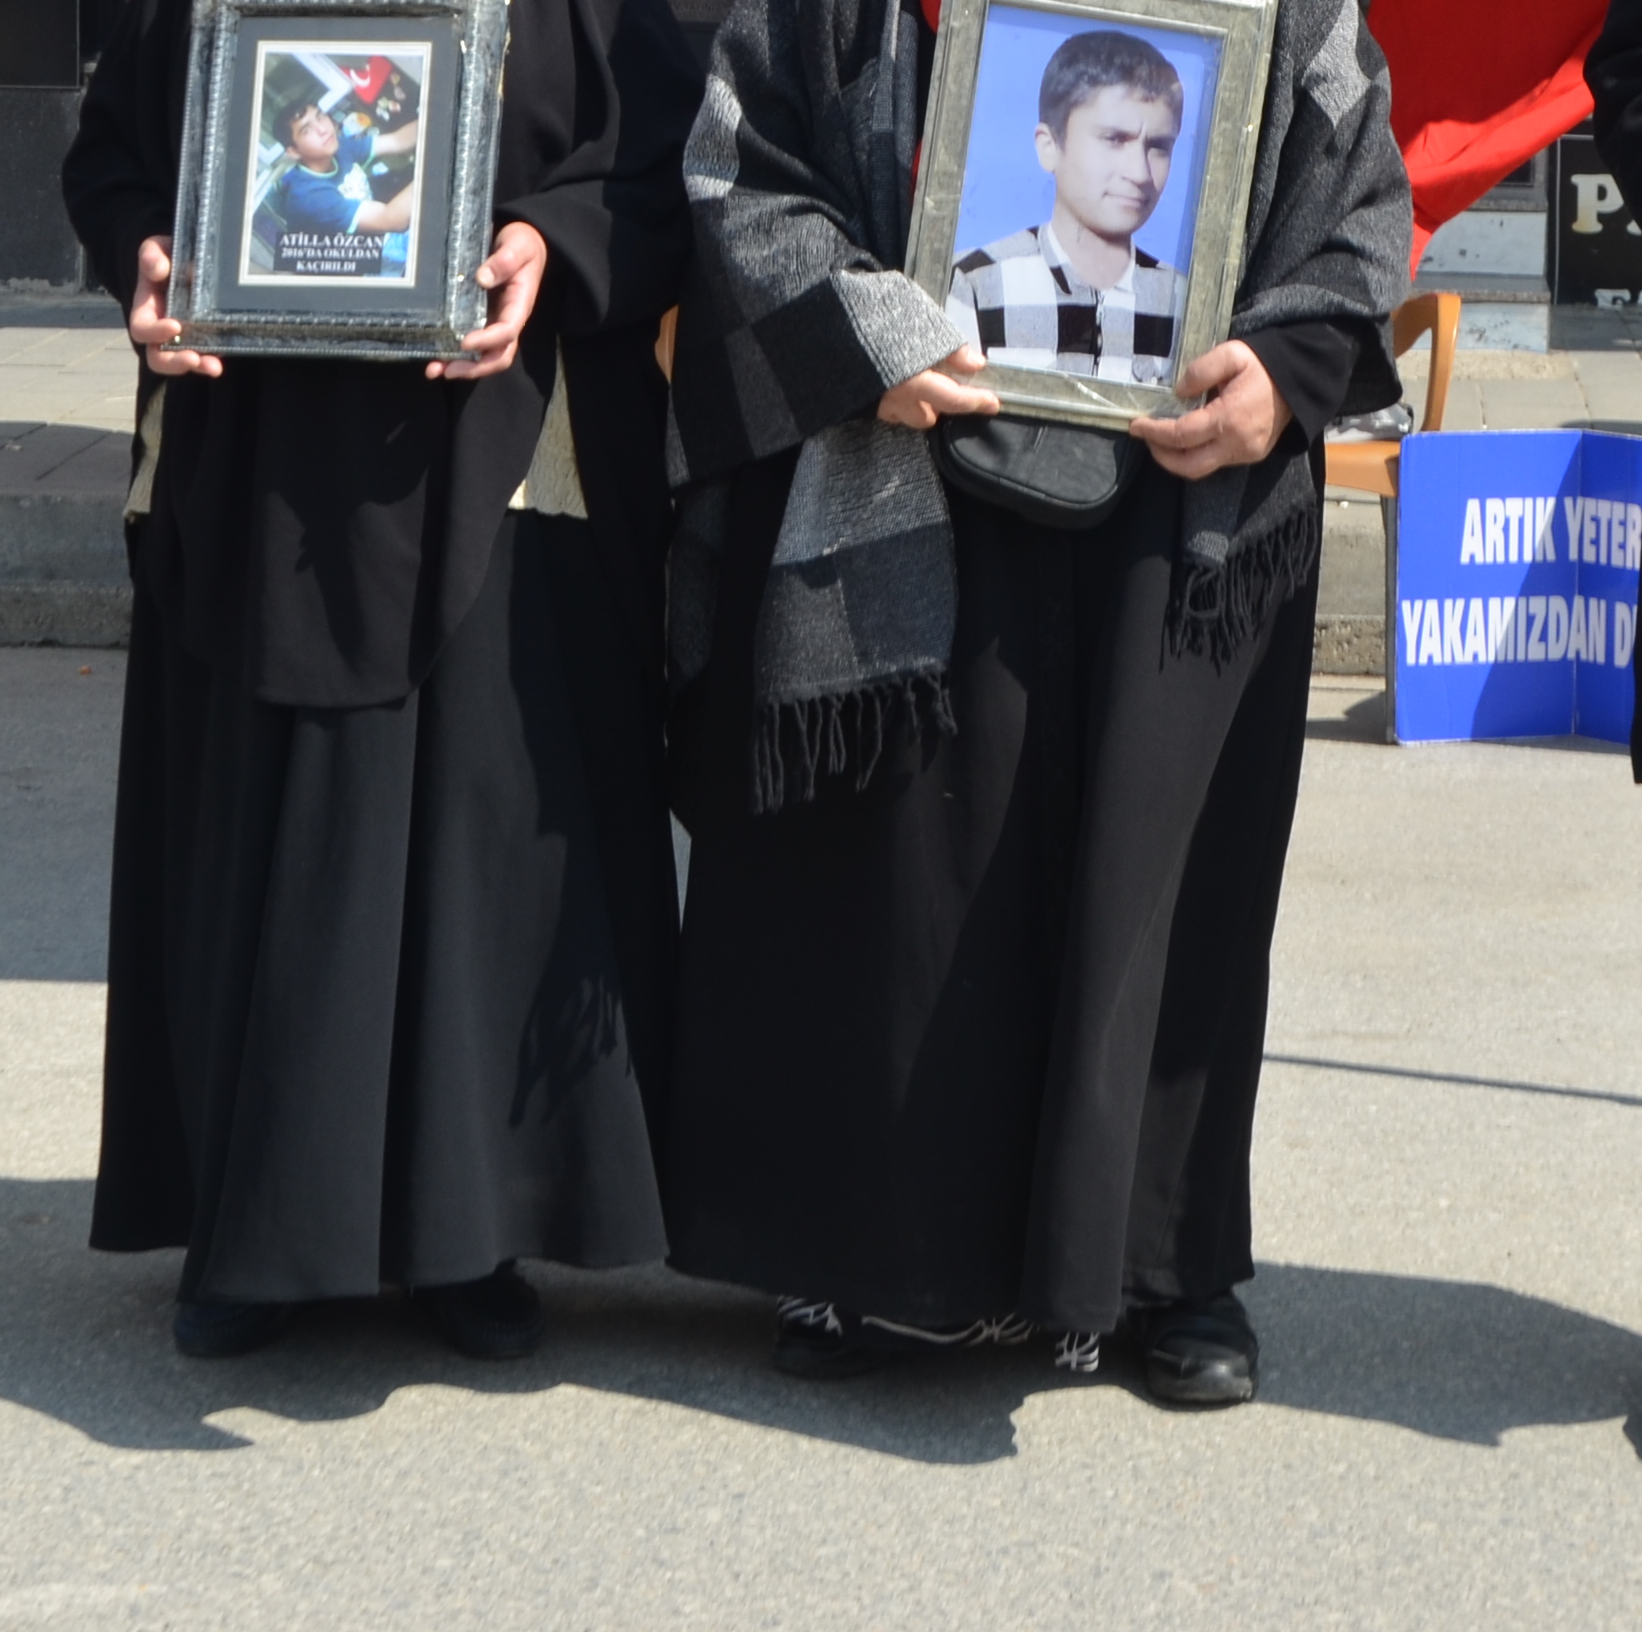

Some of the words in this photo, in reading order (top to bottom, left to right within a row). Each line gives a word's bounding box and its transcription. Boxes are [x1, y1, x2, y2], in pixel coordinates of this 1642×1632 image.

[280, 232, 331, 247] ATİLLA
[333, 233, 383, 248] ÖZCAN
[324, 248, 380, 259] OKULDAN
[296, 260, 356, 273] KAÇIRILDI
[1460, 497, 1557, 565] ARTIK
[1401, 594, 1607, 666] YAKAMIZDAN
